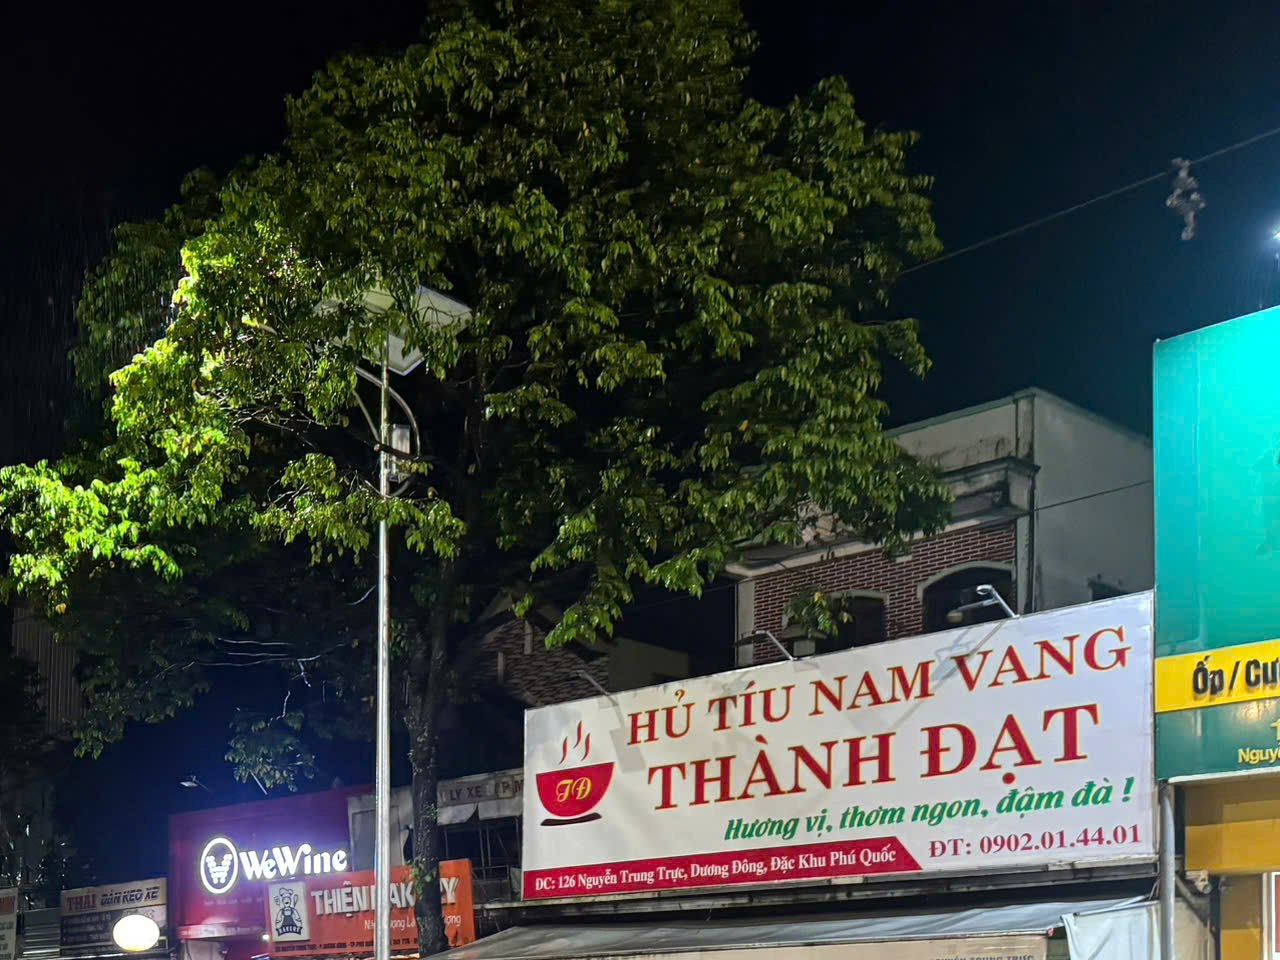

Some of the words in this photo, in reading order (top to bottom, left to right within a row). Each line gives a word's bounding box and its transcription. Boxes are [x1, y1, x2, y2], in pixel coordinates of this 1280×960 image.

[627, 689, 695, 745] HỦ
[708, 680, 795, 731] TÍU
[809, 660, 935, 716] NAM
[951, 625, 1131, 692] VANG
[1192, 655, 1224, 696] Ốp
[648, 732, 896, 810] THÀNH
[920, 704, 1098, 784] ĐẠT
[1238, 747, 1280, 764] Nguy
[724, 818, 799, 841] Hương
[806, 808, 832, 838] vị,
[840, 805, 905, 830] thơm
[911, 798, 988, 826] ngon,
[996, 786, 1064, 818] đậm
[1071, 777, 1113, 807] đà
[239, 843, 348, 880] WeWine
[928, 837, 972, 858] ĐT:
[979, 823, 1142, 854] 0902.01.44.01
[558, 874, 576, 889] 126
[578, 868, 617, 889] Nguyễn
[620, 871, 654, 885] Trung
[656, 866, 688, 883] Trực,
[691, 862, 729, 879] Dương
[731, 858, 767, 877] Đông,
[771, 855, 795, 873] Đặc
[799, 853, 826, 869] Khu
[830, 850, 856, 867] Phú
[860, 843, 896, 867] Quốc
